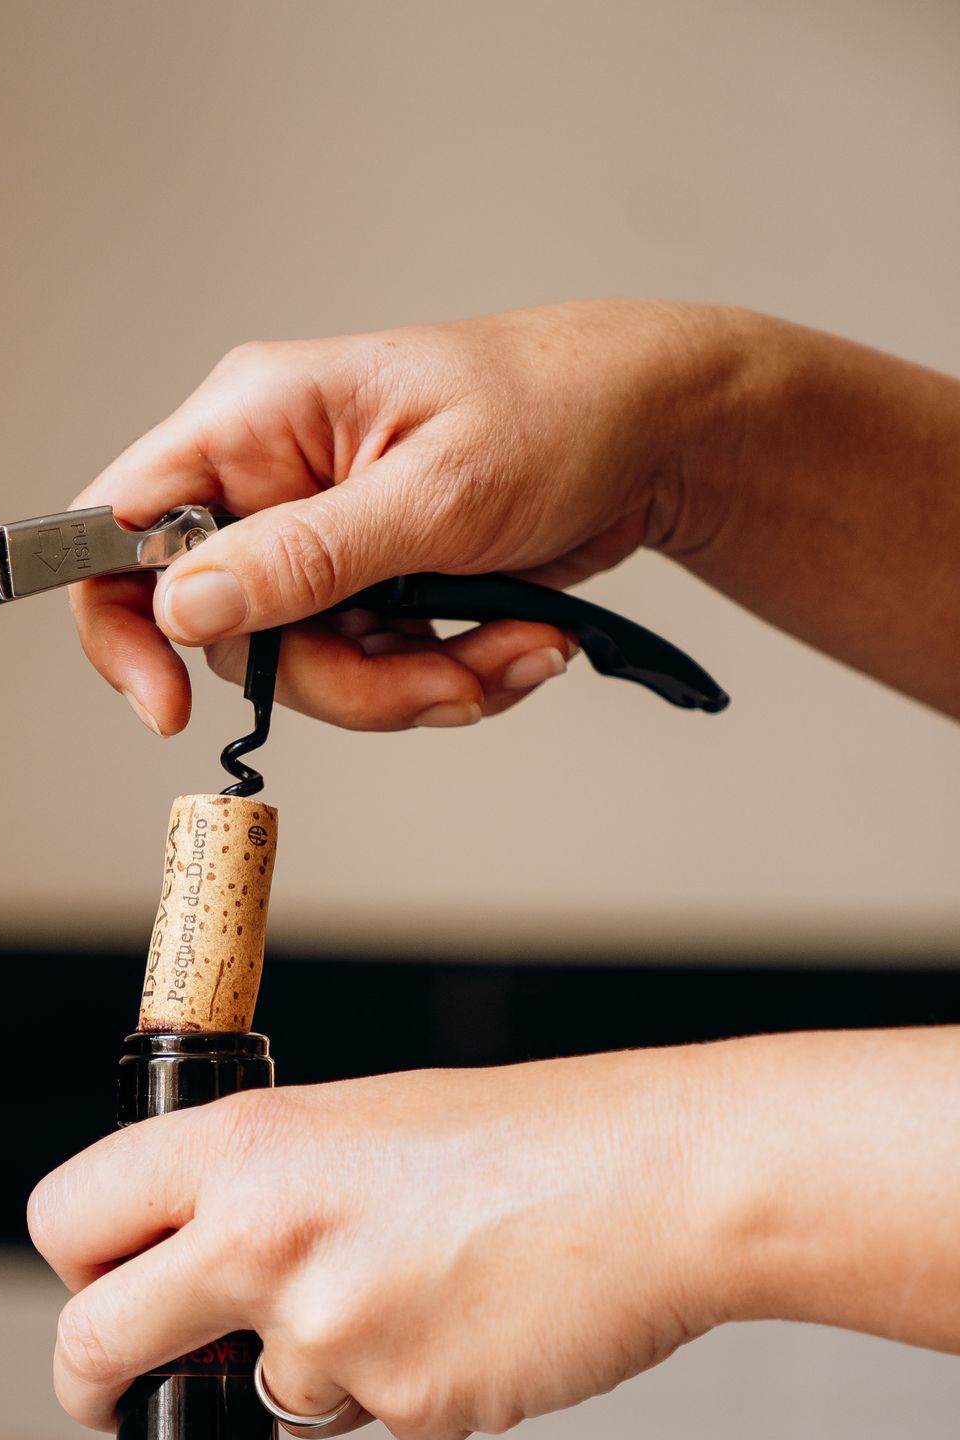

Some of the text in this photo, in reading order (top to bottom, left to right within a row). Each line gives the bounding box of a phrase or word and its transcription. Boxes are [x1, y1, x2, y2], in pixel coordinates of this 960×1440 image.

[71, 523, 91, 569] PUSH
[167, 818, 207, 1003] Pesquera de Duero
